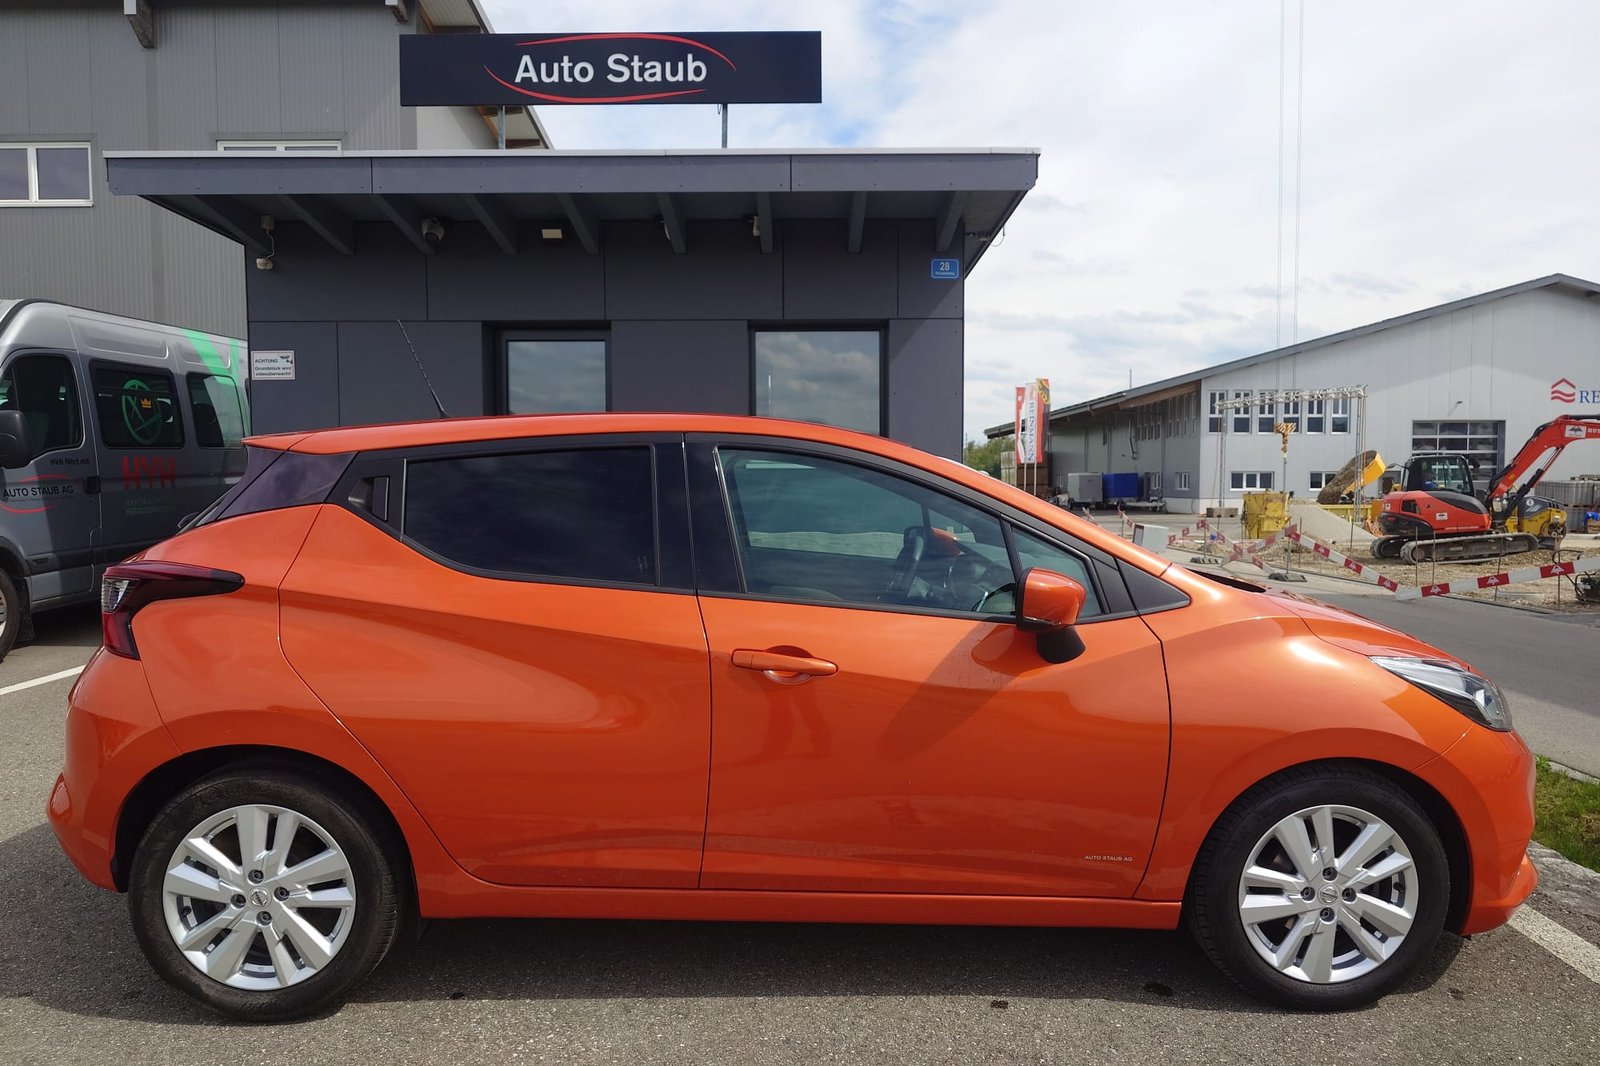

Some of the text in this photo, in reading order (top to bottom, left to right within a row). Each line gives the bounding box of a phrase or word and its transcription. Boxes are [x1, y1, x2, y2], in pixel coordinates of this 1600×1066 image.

[514, 53, 707, 83] Auto Staub
[940, 261, 950, 271] 28
[121, 454, 177, 491] HVH
[3, 485, 74, 498] AUTO STAUB AG
